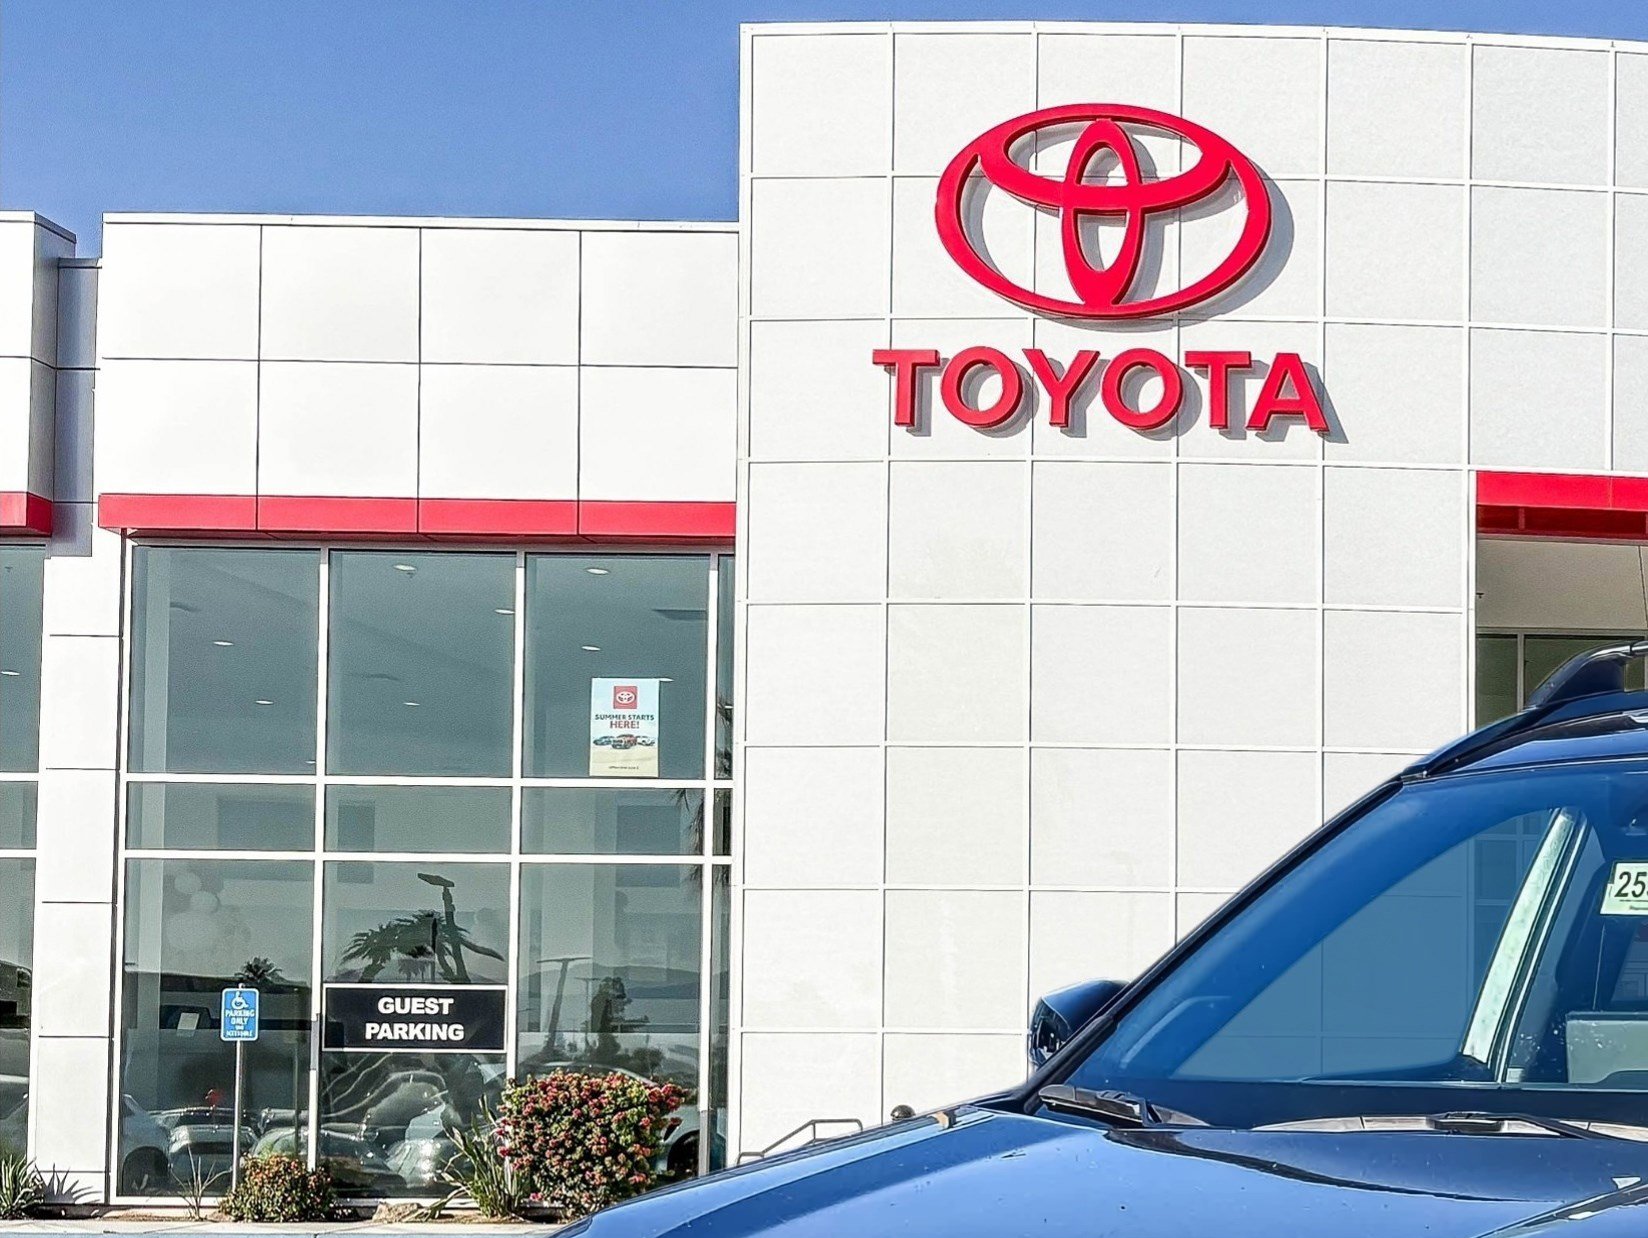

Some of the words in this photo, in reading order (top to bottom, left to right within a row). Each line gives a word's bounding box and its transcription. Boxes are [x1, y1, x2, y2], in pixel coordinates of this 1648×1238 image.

[872, 345, 1332, 434] TOYOTA
[594, 713, 628, 721] SUMMER
[627, 713, 655, 721] STARTS
[609, 720, 640, 730] HERE!
[377, 996, 455, 1015] GUEST
[364, 1022, 465, 1041] PARKING
